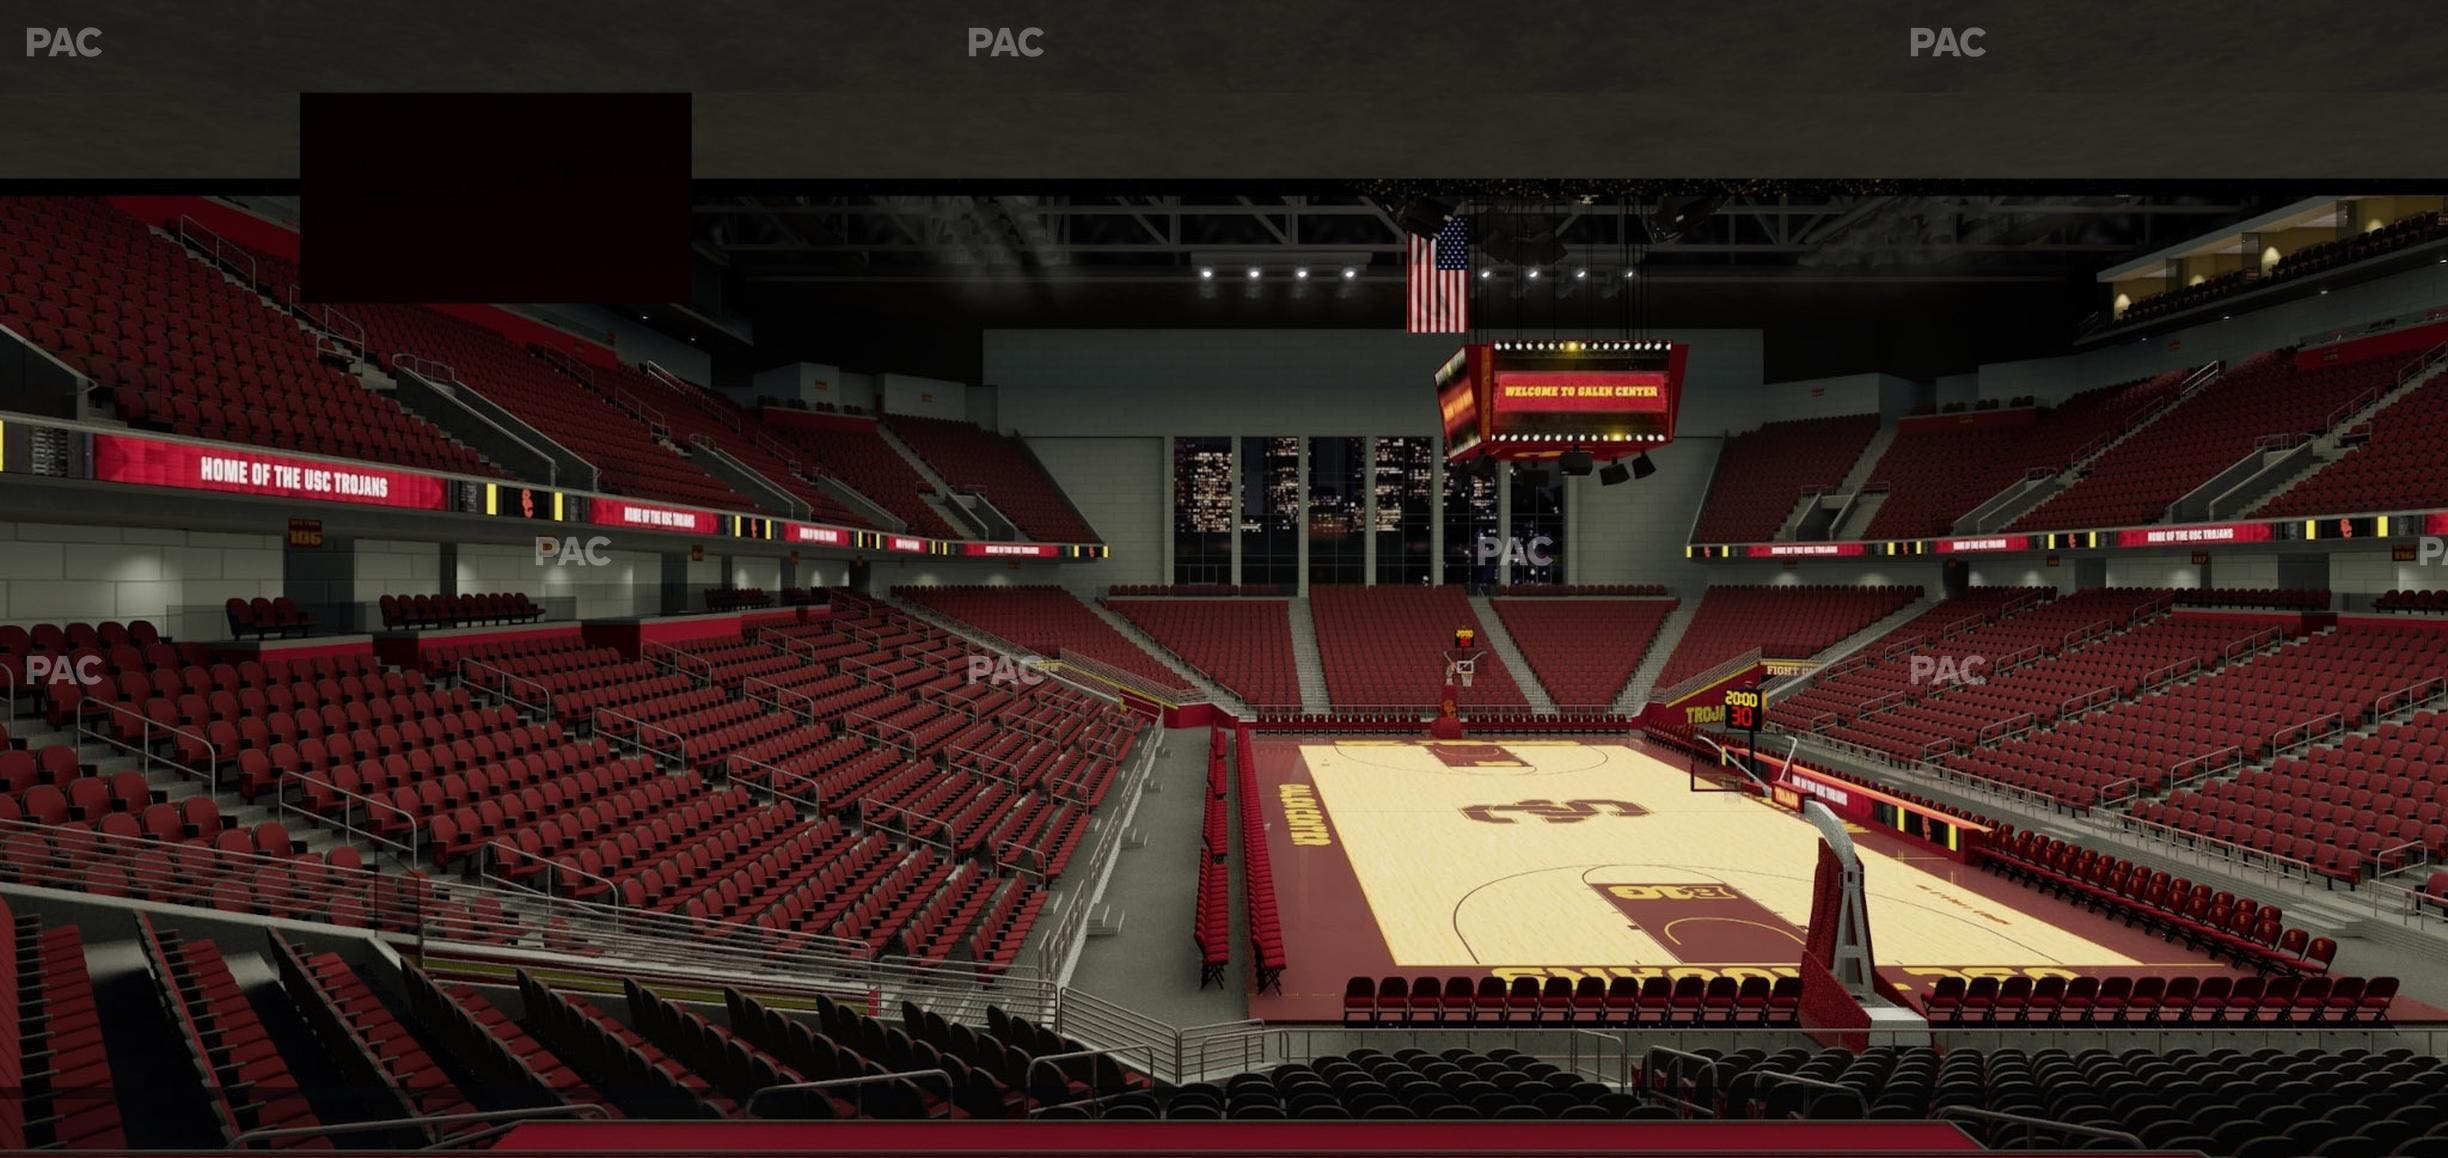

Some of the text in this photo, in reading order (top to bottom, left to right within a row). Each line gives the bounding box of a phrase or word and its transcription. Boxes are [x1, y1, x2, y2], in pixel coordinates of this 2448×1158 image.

[1505, 386, 1657, 397] WELCOME TO GALEN CENTER
[201, 456, 388, 498] HOME OF THE USC TROJANS
[1767, 665, 1799, 676] FIGHT
[1725, 689, 1758, 708] 20:00
[1731, 706, 1753, 727] 30
